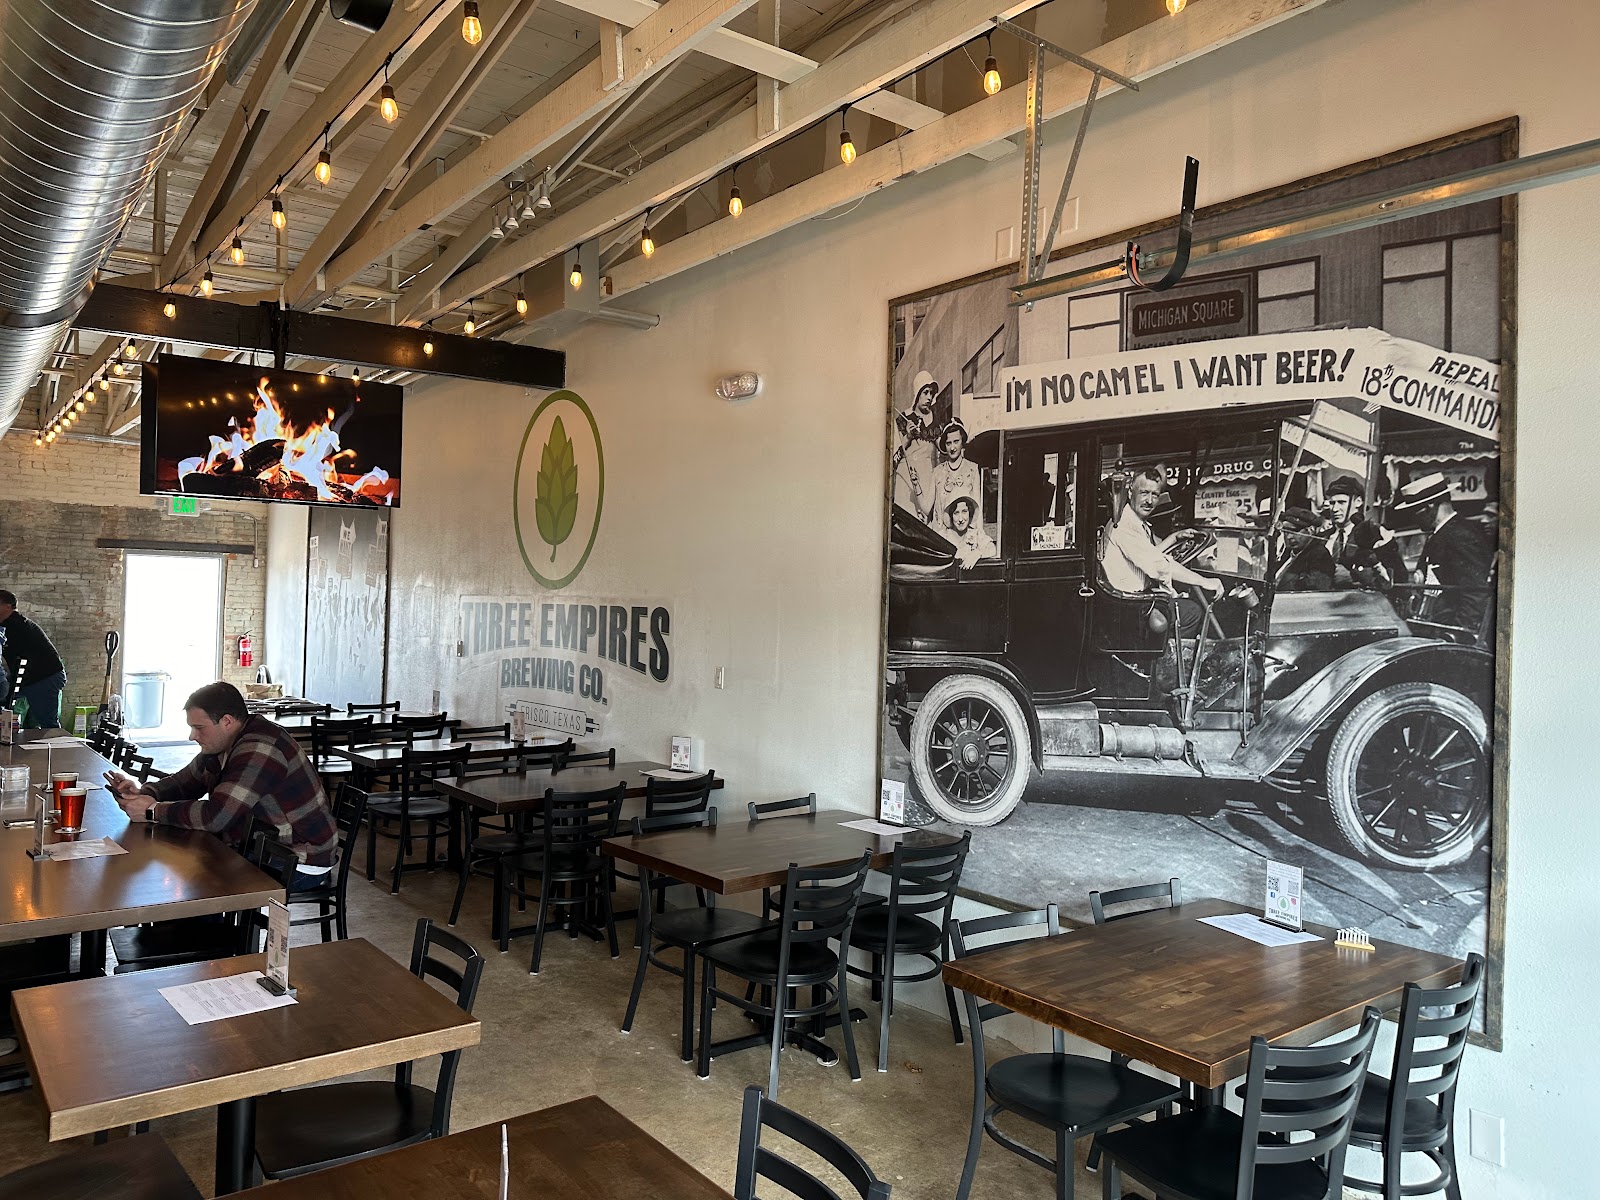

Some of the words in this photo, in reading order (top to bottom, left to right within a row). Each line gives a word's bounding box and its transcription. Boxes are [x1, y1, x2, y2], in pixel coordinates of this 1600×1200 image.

[1138, 305, 1188, 330] MICHIGAN
[1192, 298, 1235, 323] SQUARE
[1006, 376, 1033, 413] I'M
[1041, 373, 1075, 406] NO
[1079, 364, 1165, 400] CAMEL
[1173, 360, 1184, 390] I
[1189, 353, 1268, 389] WANT
[1276, 348, 1355, 385] BEER!
[1428, 356, 1500, 393] REPEAL
[1213, 460, 1255, 475] DRUG
[173, 496, 196, 513] EXIT
[462, 602, 532, 658] THREE
[540, 603, 670, 683] EMPIRES
[501, 657, 575, 694] BREWING
[579, 664, 608, 705] CO.
[552, 710, 581, 731] TEXAS
